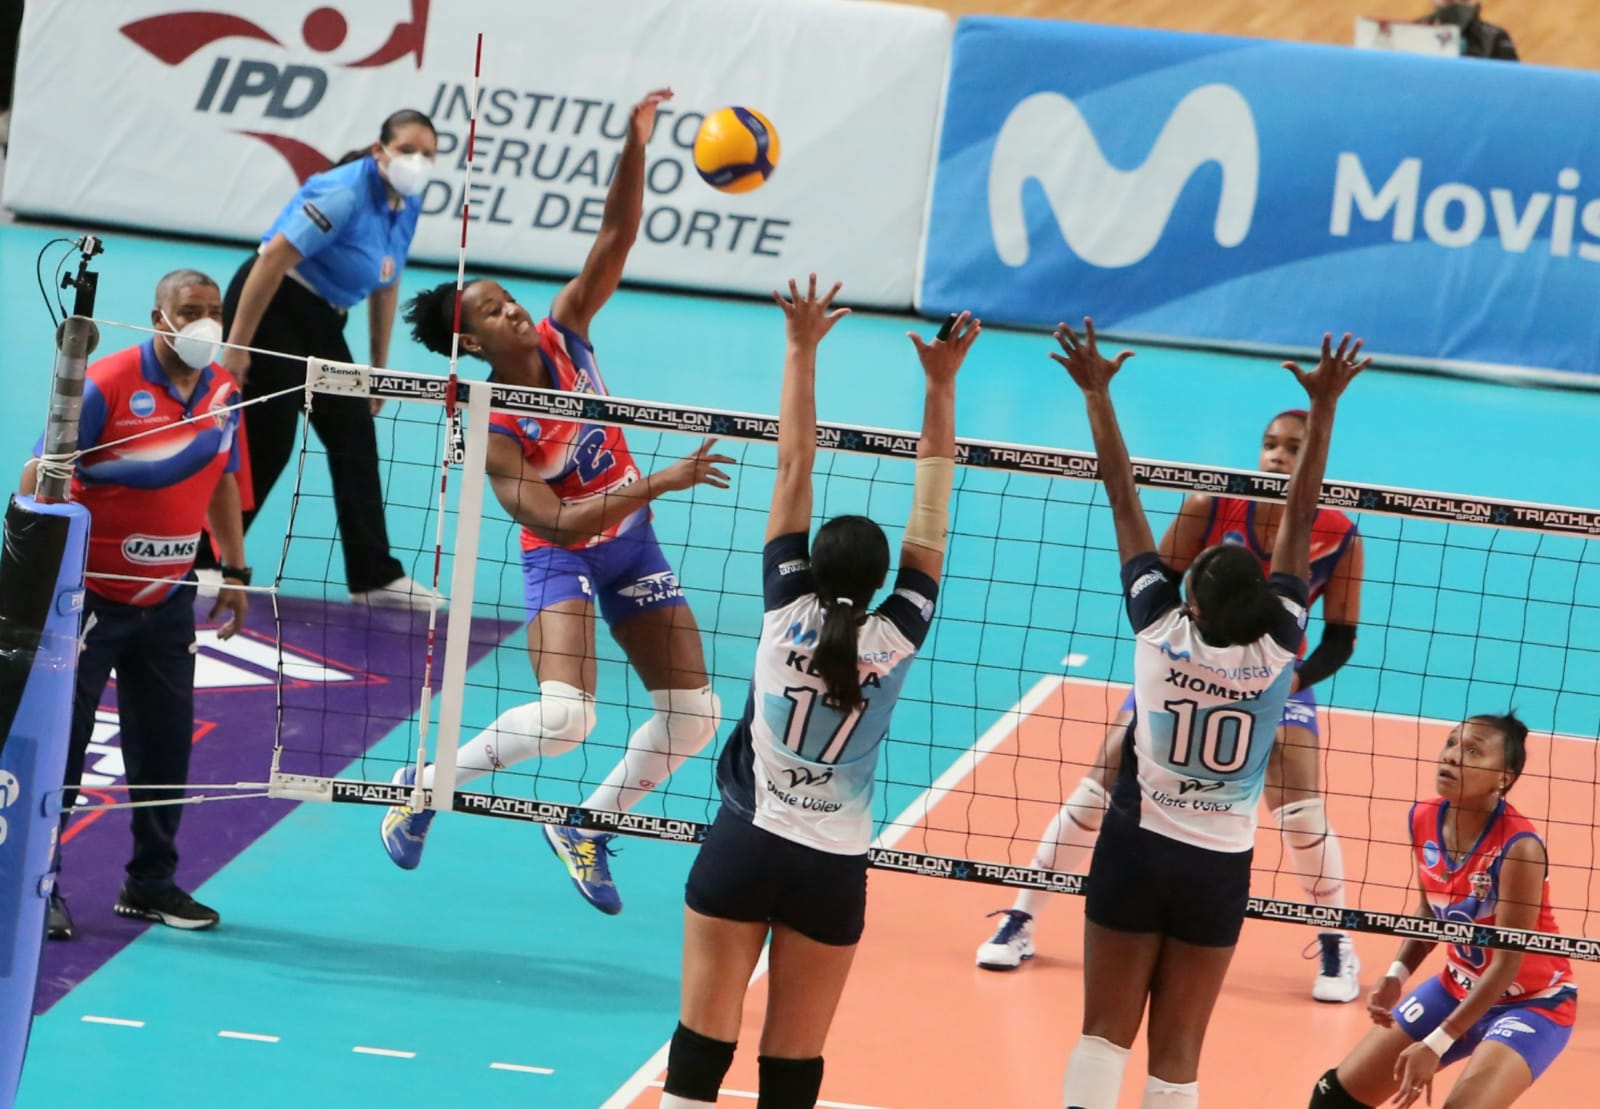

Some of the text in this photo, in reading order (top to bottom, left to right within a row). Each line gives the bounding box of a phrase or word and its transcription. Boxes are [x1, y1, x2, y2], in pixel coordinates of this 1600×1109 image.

[195, 57, 328, 119] IPD
[420, 178, 791, 257] DEL DEORTE
[330, 366, 361, 377] Senoh
[491, 386, 584, 411] RIATHLON
[549, 406, 583, 417] SPORT
[605, 402, 713, 426] TRIATHLON
[677, 423, 711, 433] SPORT
[733, 417, 841, 442] TRIAON
[573, 428, 616, 486] 2
[990, 448, 1098, 472] TRIATHLON
[1063, 468, 1097, 479] SPORT
[1132, 465, 1229, 487] RIATHLON
[1193, 483, 1227, 493] SPORT
[1250, 477, 1360, 501] TRIALON
[1324, 497, 1358, 507] SPORT
[1381, 491, 1492, 516] TRIATHLON
[1456, 513, 1490, 523] SPORT
[1164, 668, 1264, 701] XIOMELY
[783, 685, 870, 766] 17
[1164, 698, 1256, 775] 10
[462, 795, 568, 819] TRIATHLON
[532, 814, 566, 825] SPORT
[589, 810, 696, 835] TRIATHLON
[659, 832, 694, 841] SPORT
[868, 849, 953, 872] IATHLON
[916, 868, 951, 878] SPORT
[974, 864, 1082, 889] TRIATHLON
[1046, 884, 1081, 894] SPORT
[1246, 899, 1342, 921] RIATHLON
[1307, 918, 1341, 929] SPORT
[1364, 913, 1475, 938] TRIATHLON
[1437, 934, 1472, 945] SPORT
[1398, 996, 1425, 1024] 10
